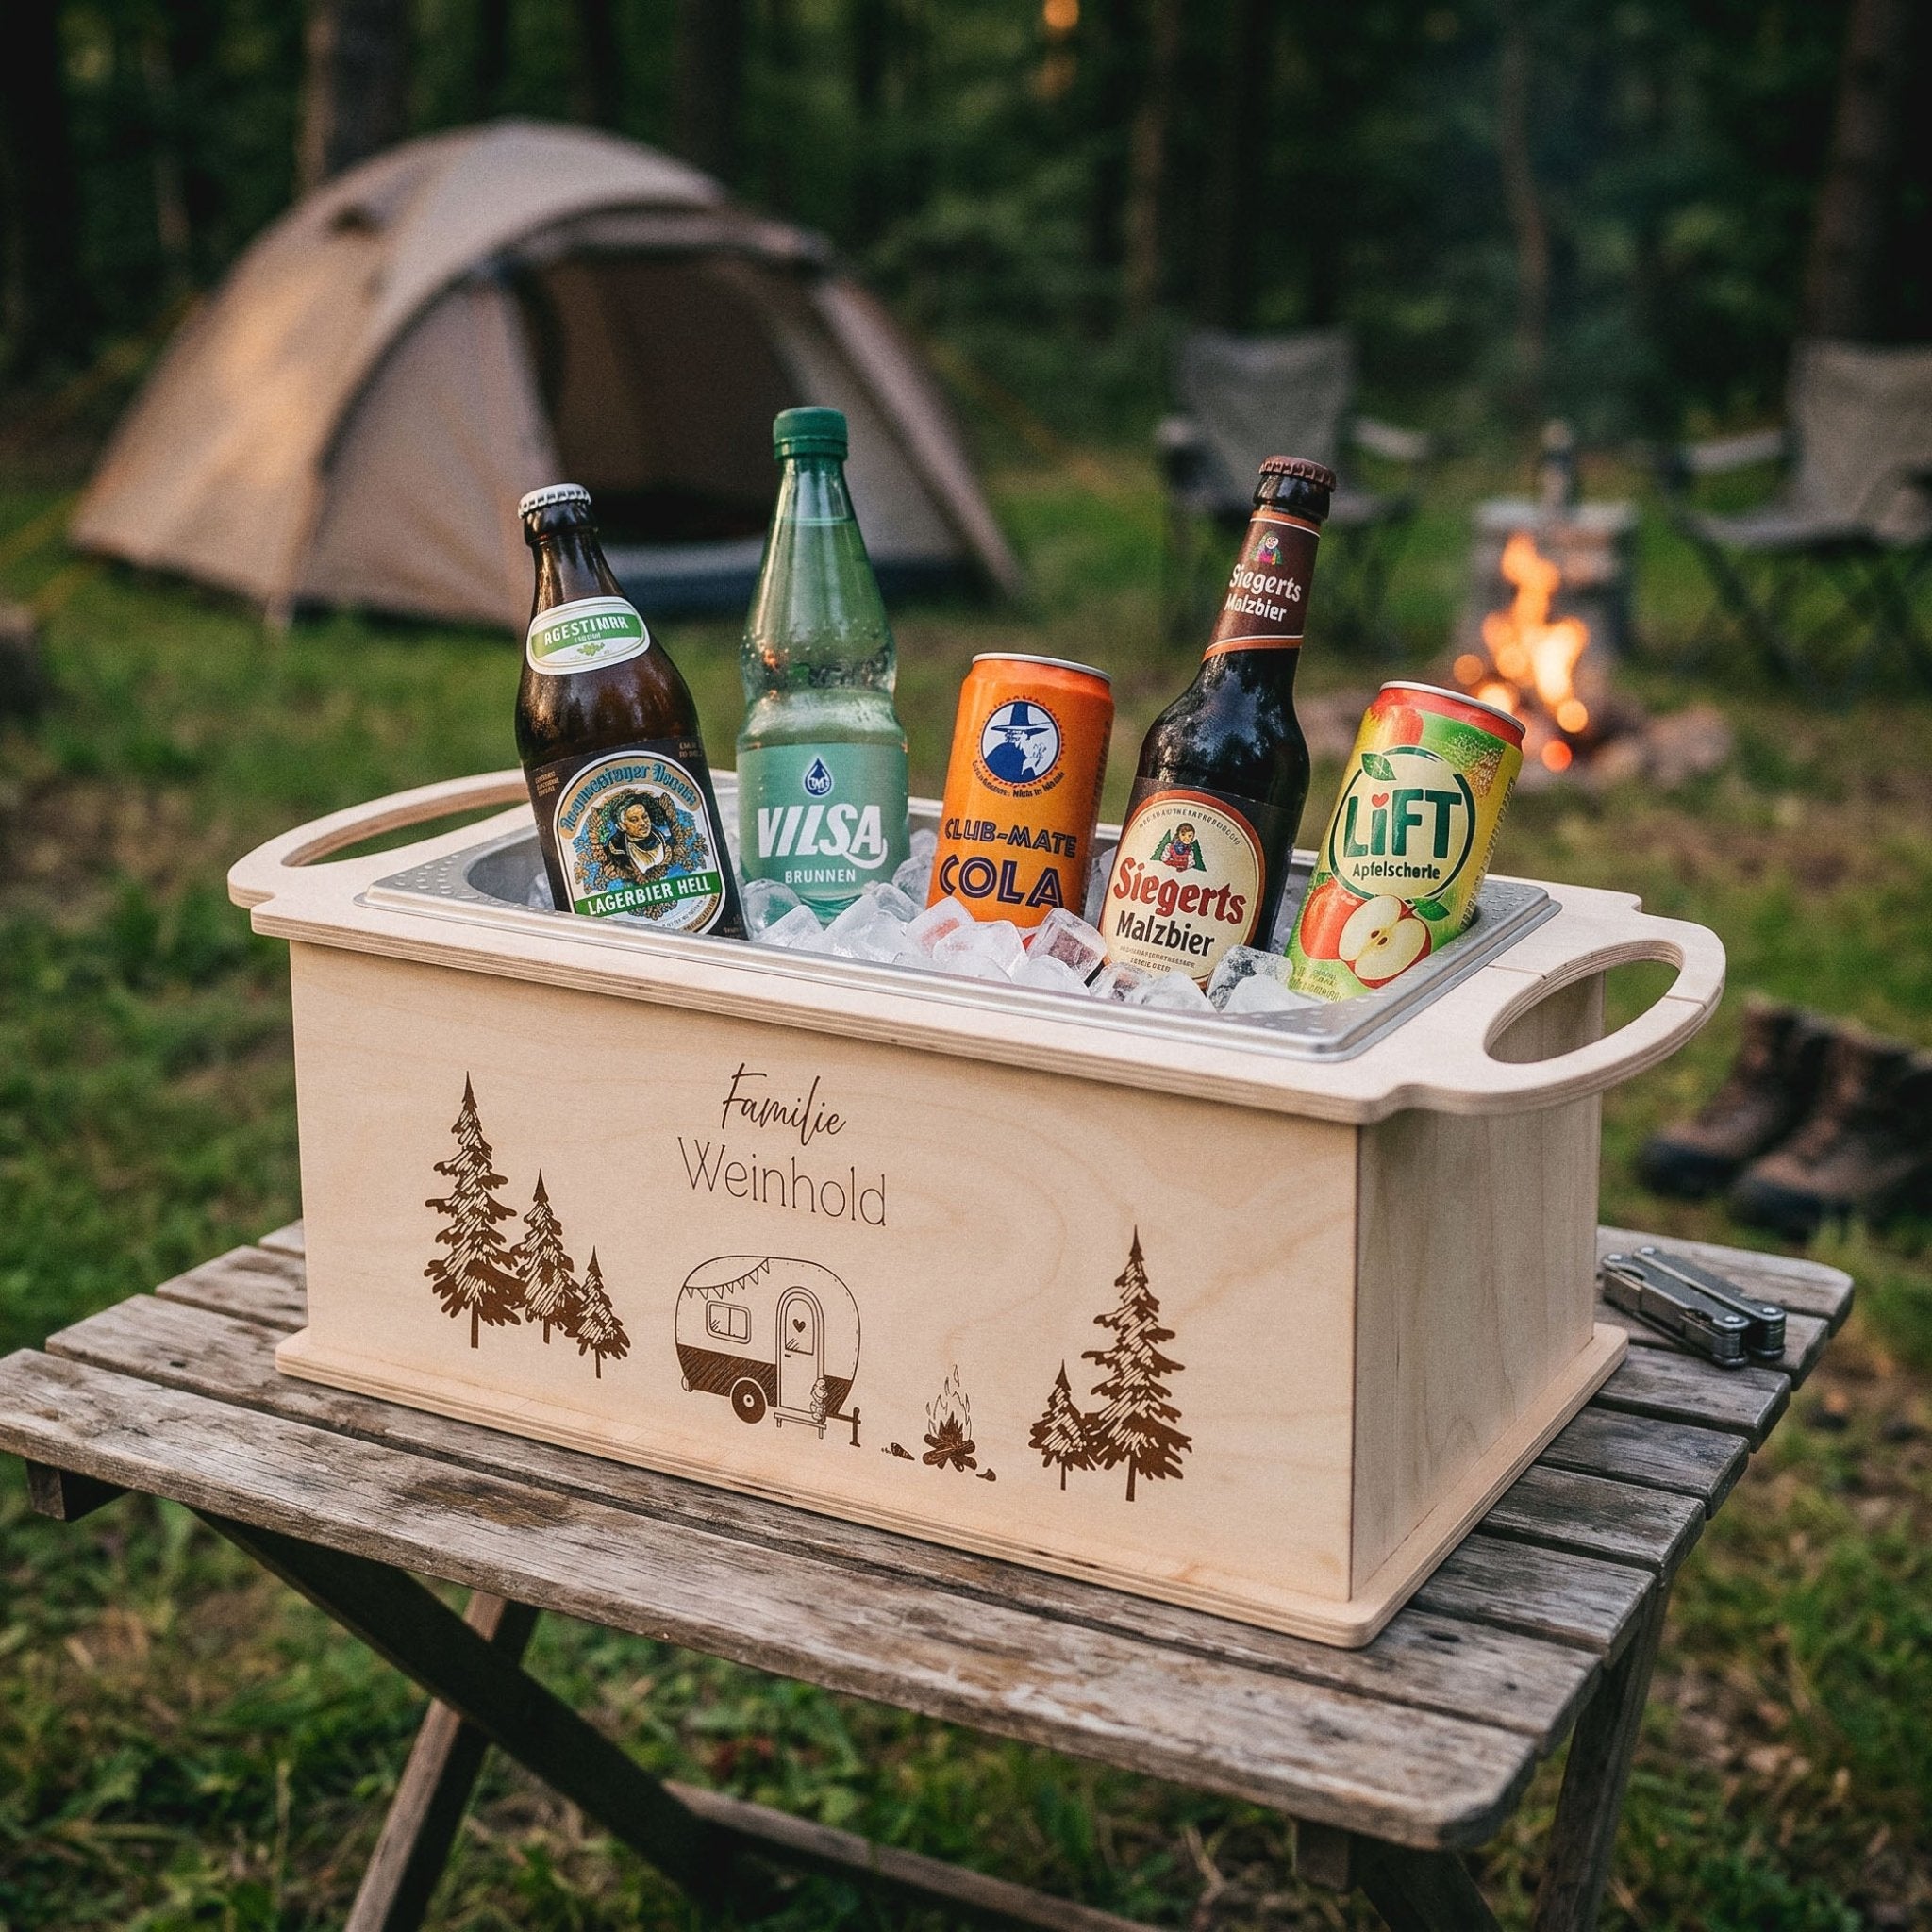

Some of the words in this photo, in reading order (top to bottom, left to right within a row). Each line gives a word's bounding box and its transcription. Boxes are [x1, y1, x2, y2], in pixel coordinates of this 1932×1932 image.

[758, 803, 888, 869] VILSA
[945, 818, 1078, 858] CLUB-MATE
[588, 881, 673, 916] LAGERBIER
[677, 875, 711, 894] HELL
[785, 869, 856, 883] BRUNNEN
[939, 854, 1065, 908] COLA
[1113, 857, 1246, 924] Siegerts
[1116, 910, 1215, 957] Malzbier
[722, 1063, 846, 1146] Familie
[678, 1137, 886, 1226] Weinhold
